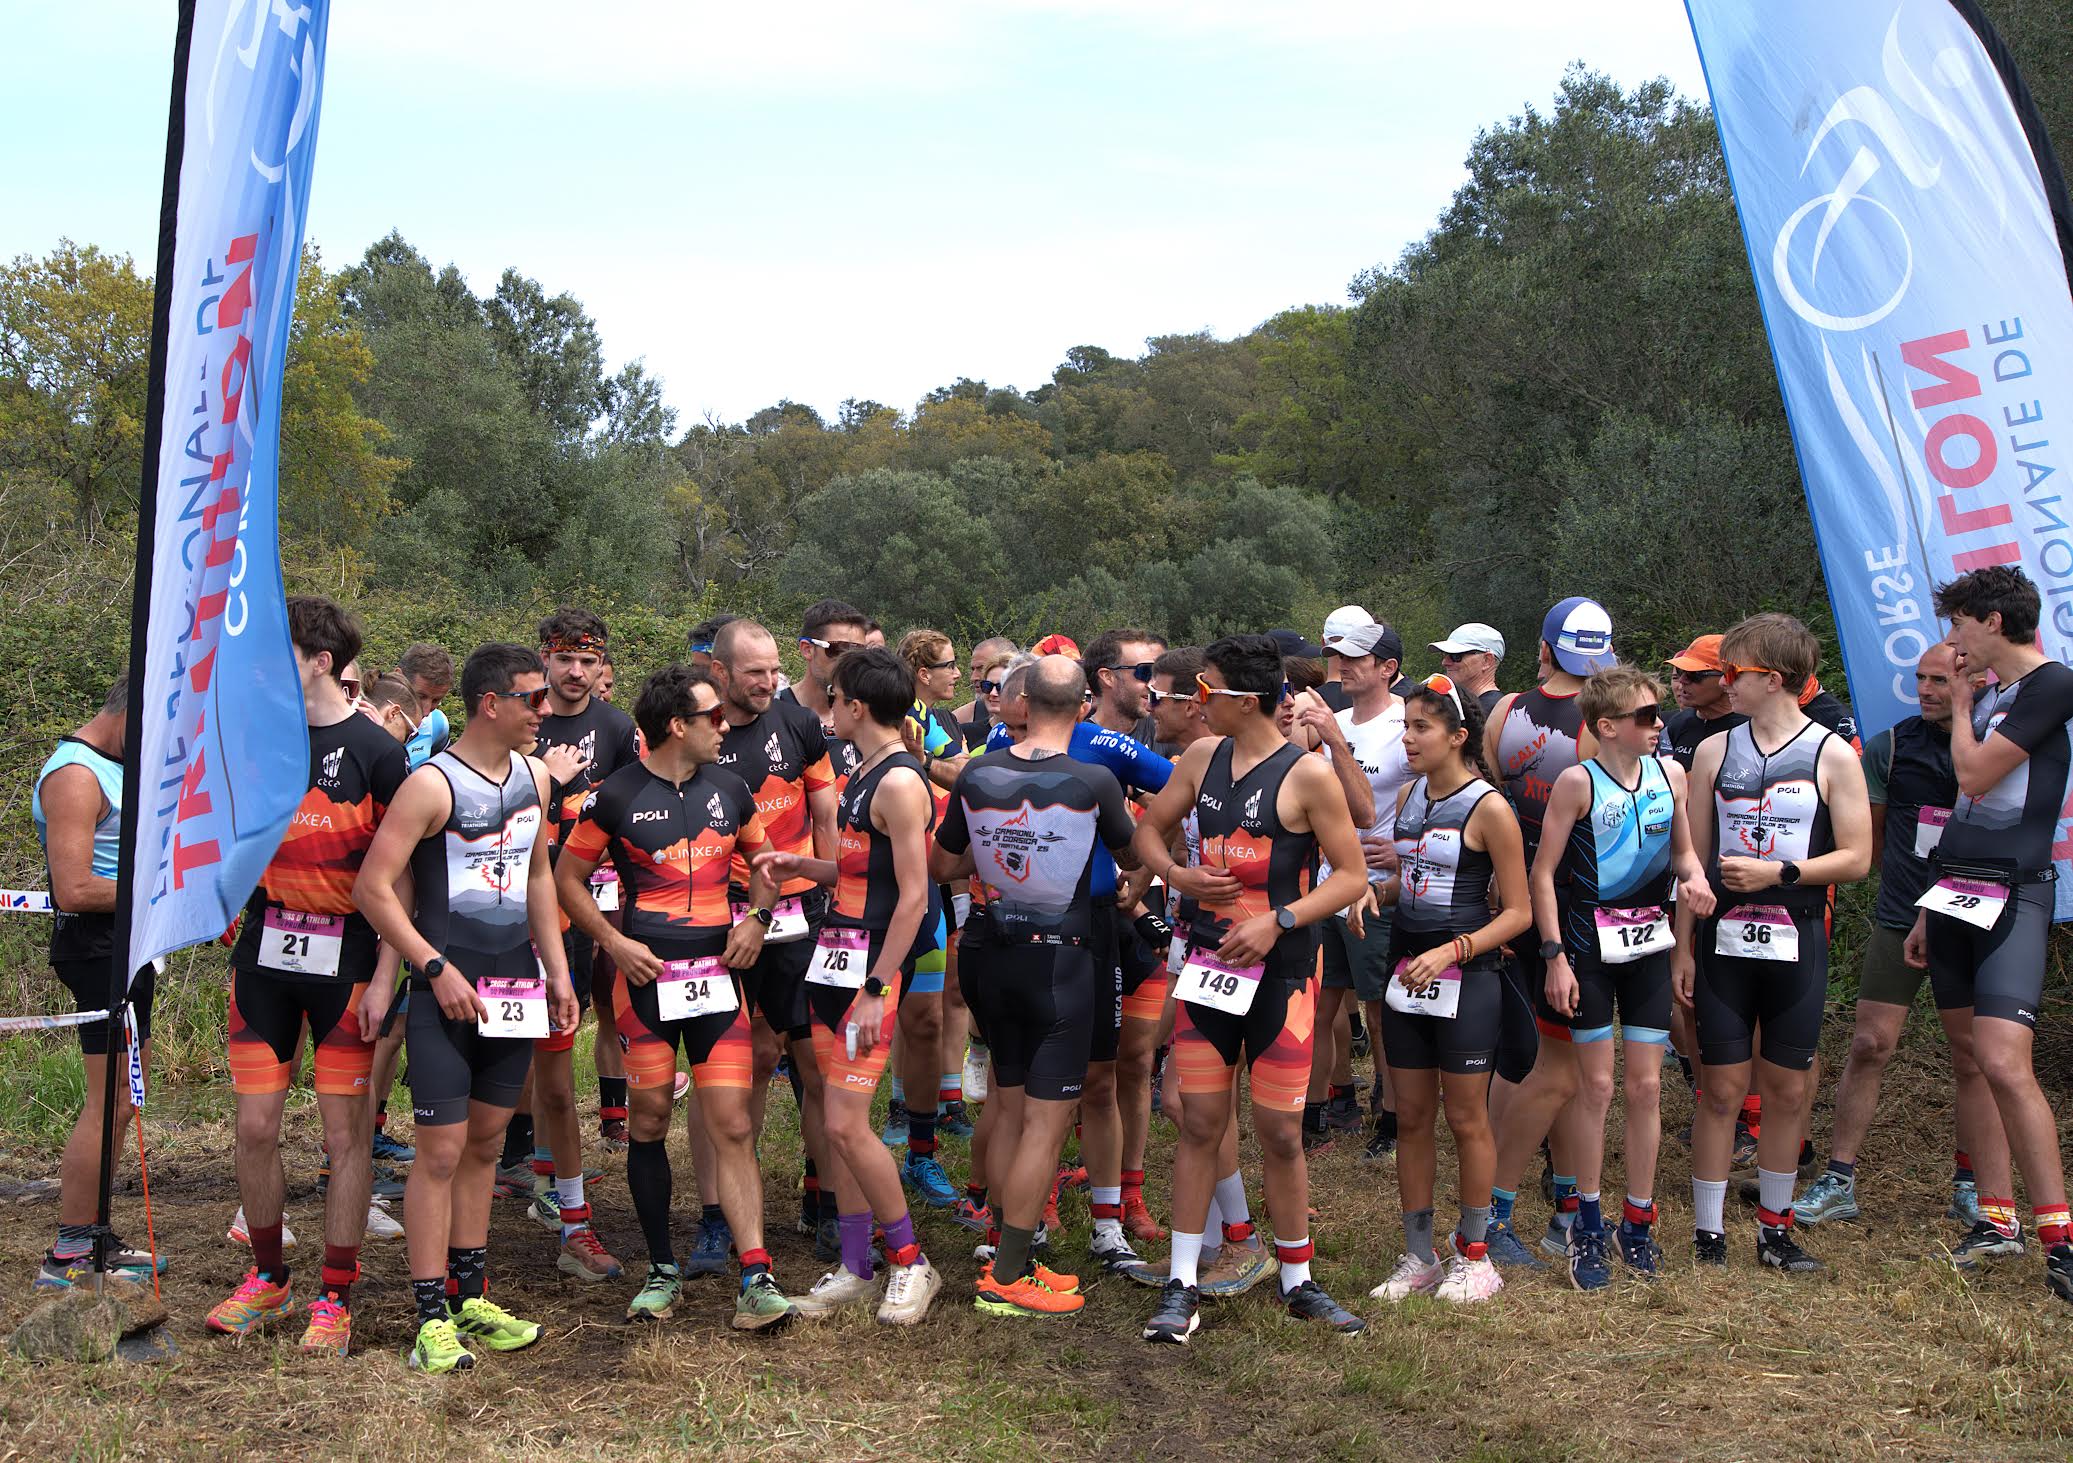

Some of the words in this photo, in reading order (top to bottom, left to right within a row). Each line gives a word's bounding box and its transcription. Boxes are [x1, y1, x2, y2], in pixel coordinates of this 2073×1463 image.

[1090, 735, 1118, 748] AUTO
[1119, 742, 1138, 760] 4X4
[1509, 732, 1547, 769] CALVI
[717, 753, 737, 765] OLI
[755, 796, 793, 813] NXEA
[1200, 793, 1222, 812] POLI
[632, 810, 669, 823] POLI
[1649, 807, 1664, 815] POLI
[292, 811, 333, 829] NXEA
[516, 815, 534, 824] POLI
[994, 828, 1035, 838] CAMPIONU
[1432, 833, 1450, 841] POLI
[997, 843, 1029, 851] TRIATHLON
[1002, 836, 1038, 846] CORSICA
[669, 846, 722, 860] LINXEA
[1209, 845, 1257, 859] LINXEA
[1948, 895, 1980, 909] 28
[1005, 914, 1028, 922] POLI
[1147, 915, 1171, 933] FOX
[1617, 923, 1655, 947] 122
[1742, 923, 1771, 944] 36
[282, 934, 310, 957] 21
[1199, 969, 1239, 996] 149
[685, 980, 711, 1001] 34
[501, 1001, 524, 1021] 23
[846, 1074, 877, 1087] POLI
[1062, 1084, 1082, 1092] POLI
[414, 1108, 434, 1117] POLI
